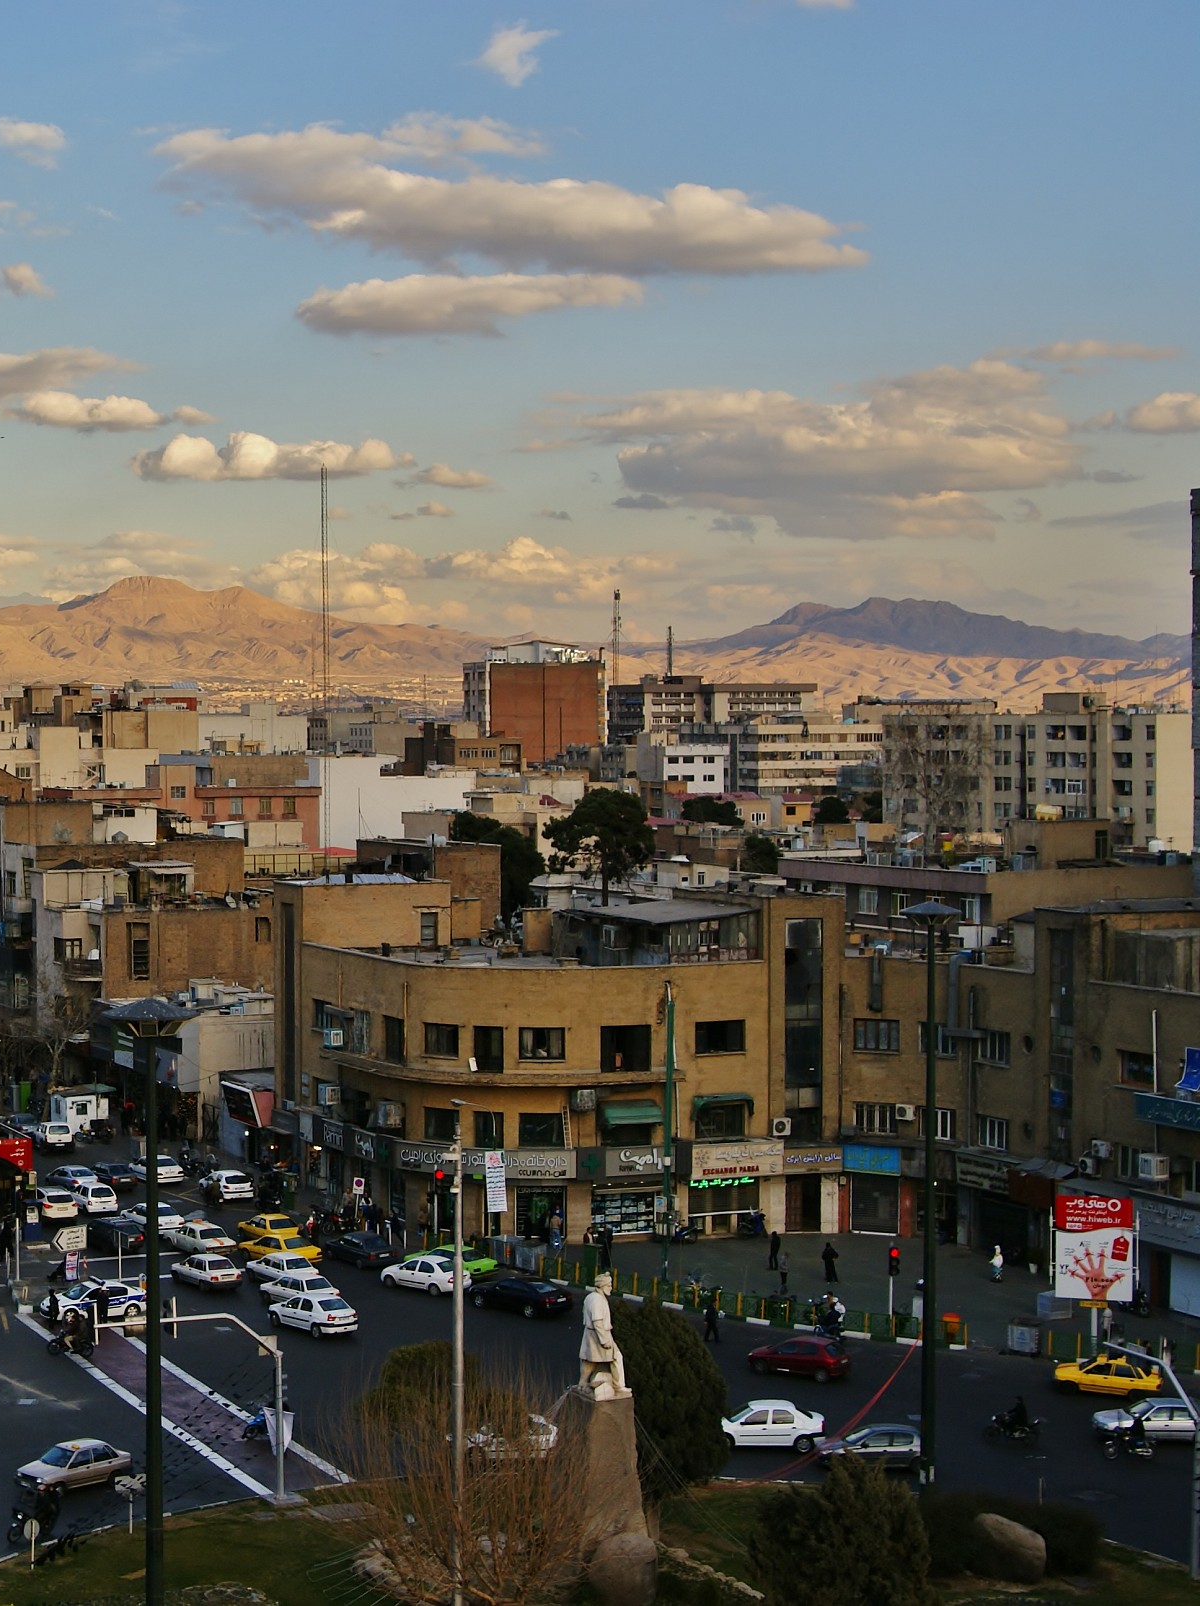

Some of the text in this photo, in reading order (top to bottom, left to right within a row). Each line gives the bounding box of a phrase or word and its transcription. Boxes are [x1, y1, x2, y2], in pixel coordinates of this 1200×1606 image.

[401, 1148, 424, 1163] رامین
[620, 1147, 663, 1171] رامین
[702, 1165, 760, 1176] EXCHANGE PARSA
[1065, 1215, 1122, 1225] www.hiweb.ir
